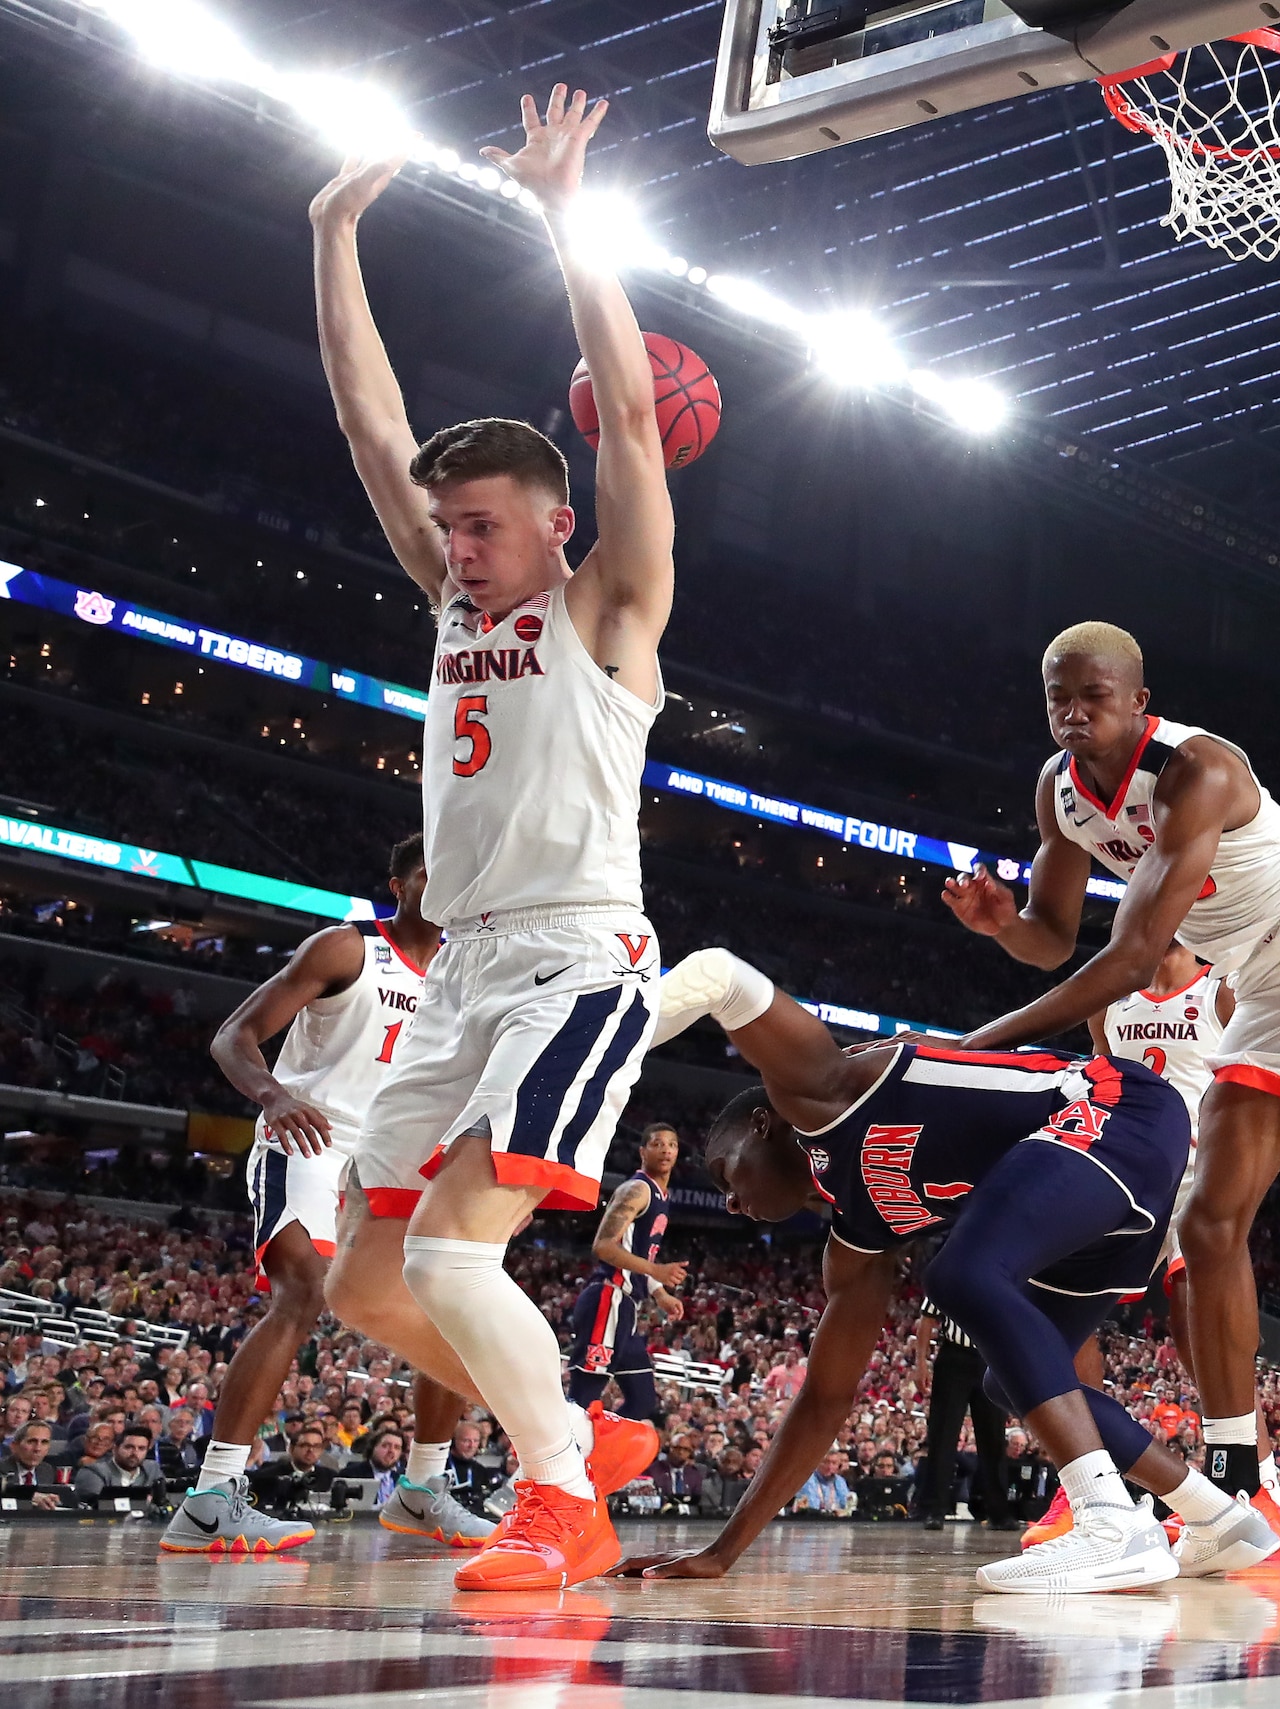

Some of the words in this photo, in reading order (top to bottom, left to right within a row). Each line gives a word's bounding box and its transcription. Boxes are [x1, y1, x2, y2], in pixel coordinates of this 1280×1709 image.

[122, 610, 196, 645] AUBURN
[198, 628, 303, 680] TIGERS
[332, 672, 356, 693] VS
[452, 695, 492, 778] 5
[667, 771, 704, 794] AND
[705, 781, 748, 807] THEN
[750, 793, 799, 821] THERE
[800, 808, 844, 834] WERE
[844, 816, 917, 858] FOUR
[377, 986, 418, 1014] VIRG
[1116, 1022, 1200, 1042] VIRGINIA
[374, 1018, 404, 1065] 1
